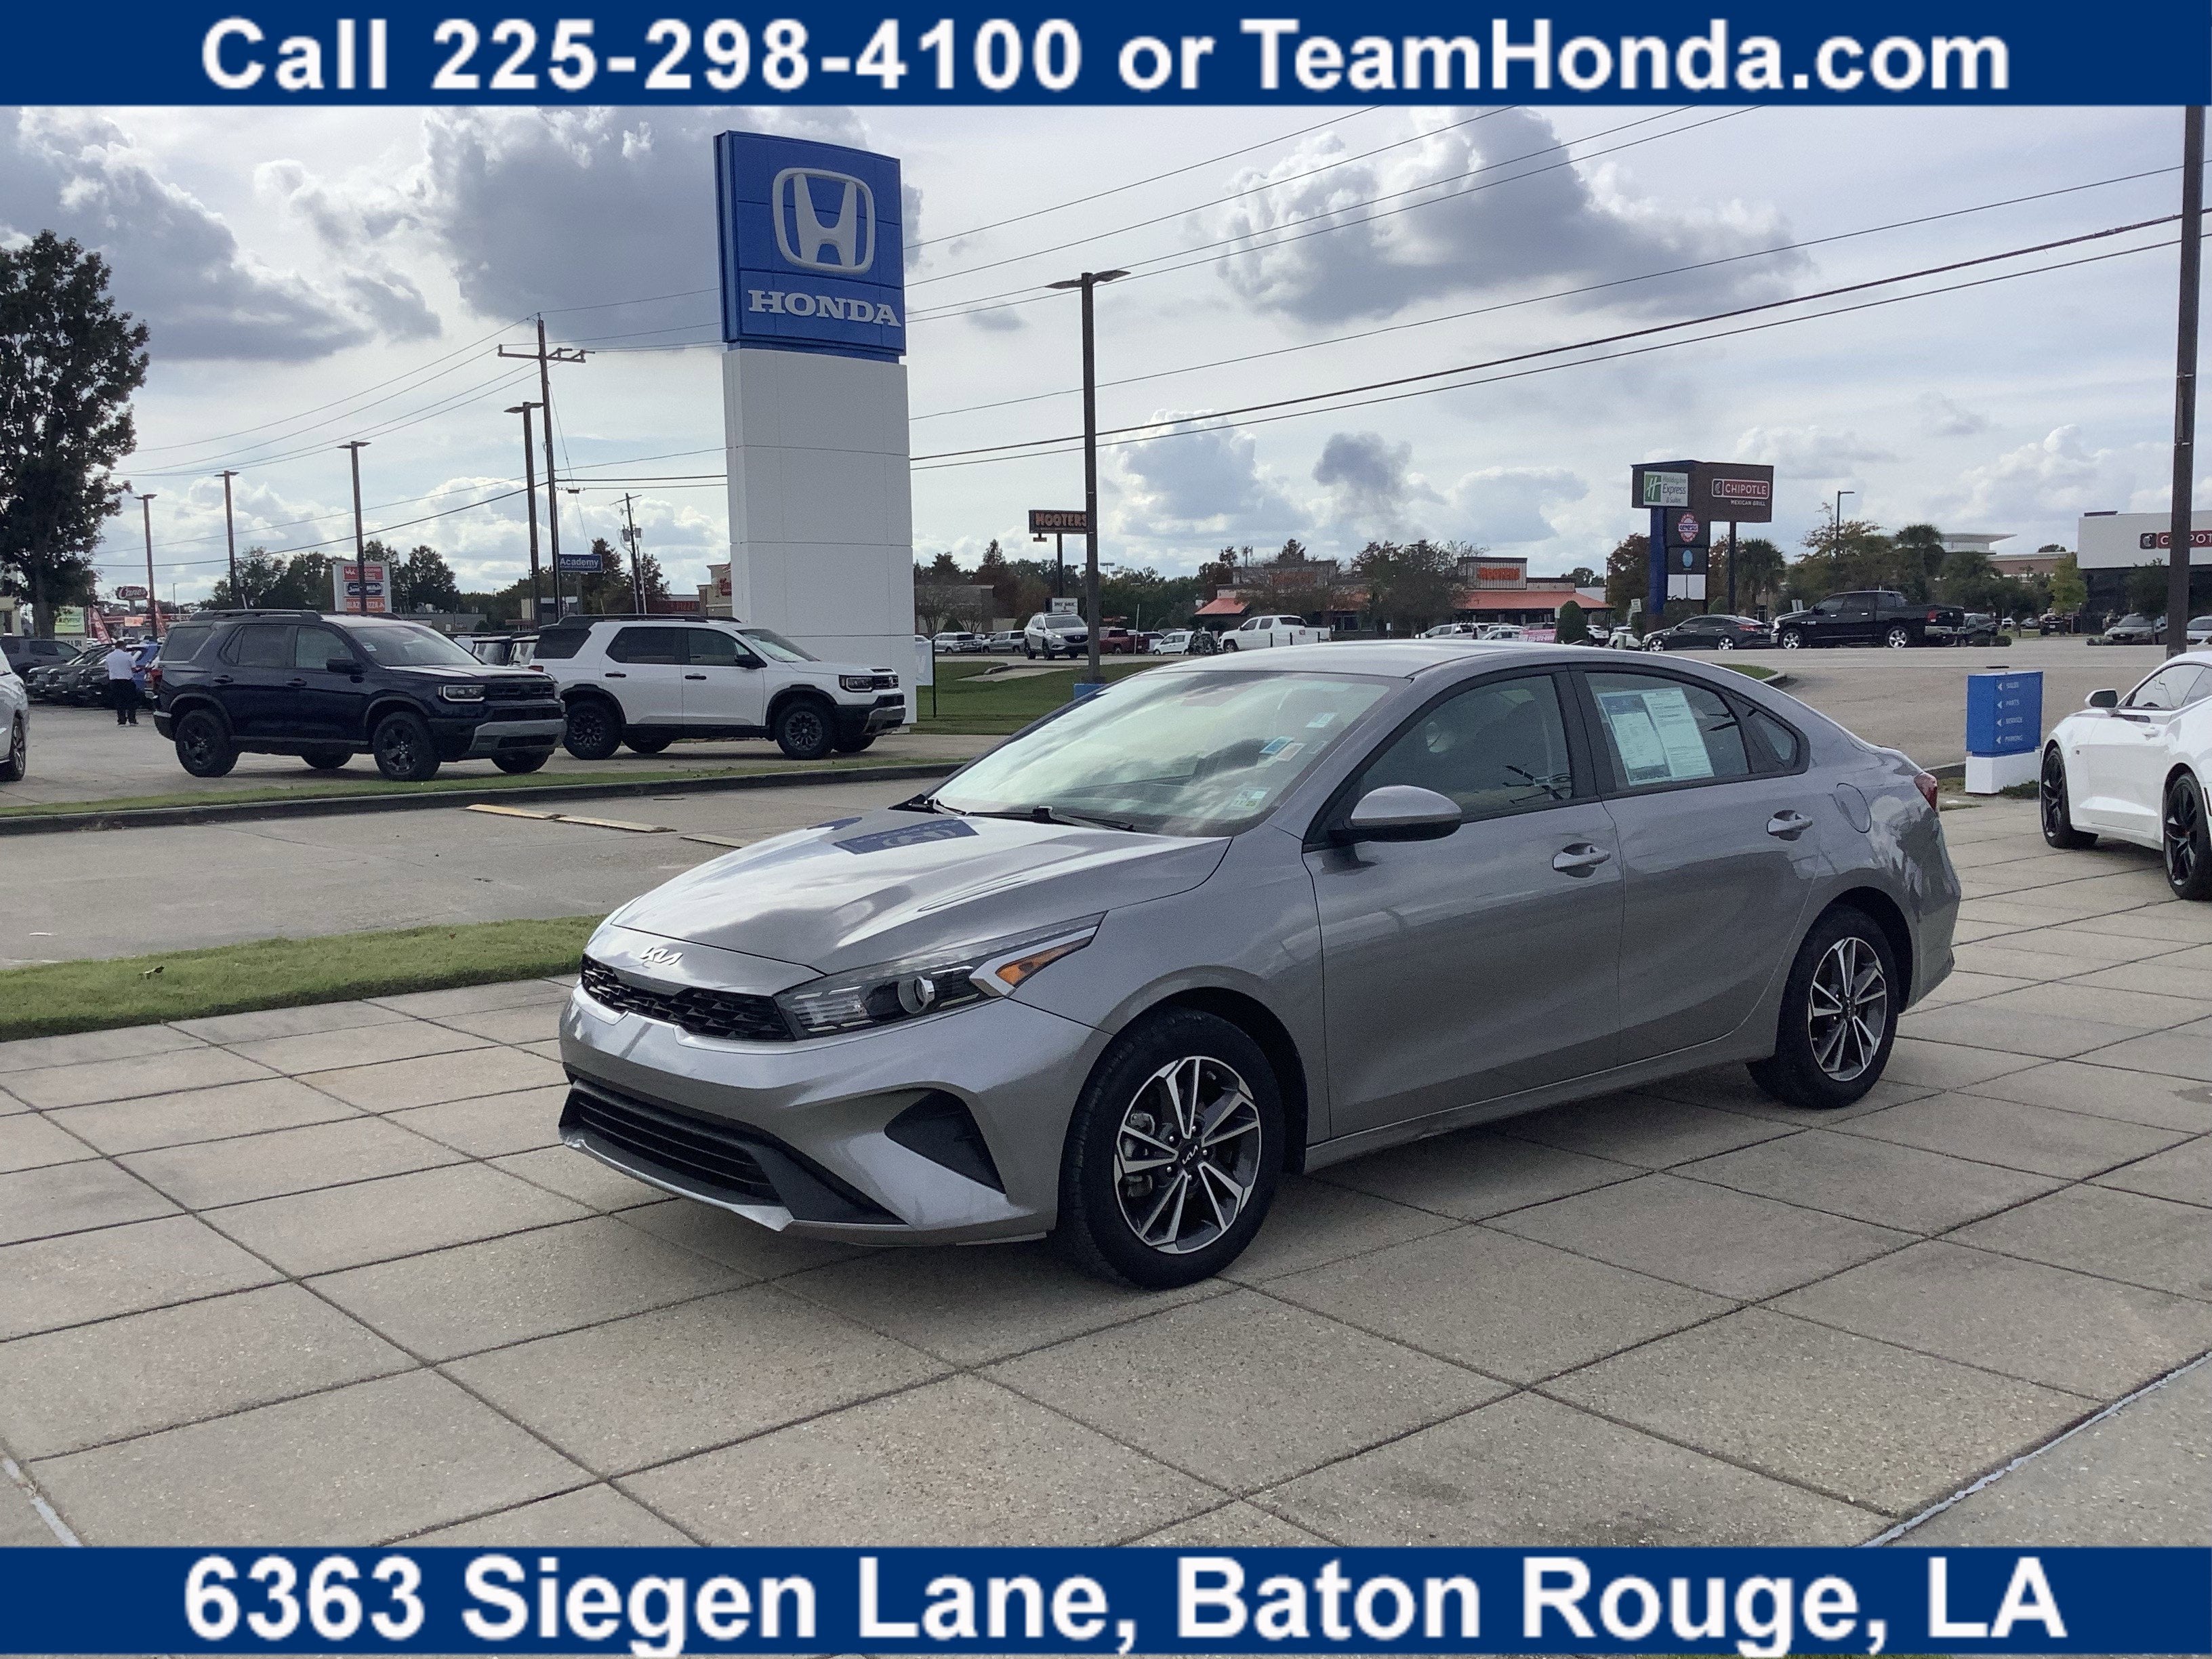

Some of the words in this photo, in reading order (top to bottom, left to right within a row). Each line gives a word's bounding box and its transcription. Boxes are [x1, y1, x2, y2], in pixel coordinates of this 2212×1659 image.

[748, 289, 901, 327] HONDA
[1662, 483, 1686, 495] Express
[1725, 484, 1767, 495] CHIPOTLE
[1036, 513, 1087, 527] HOOTERS
[560, 557, 598, 569] Academy
